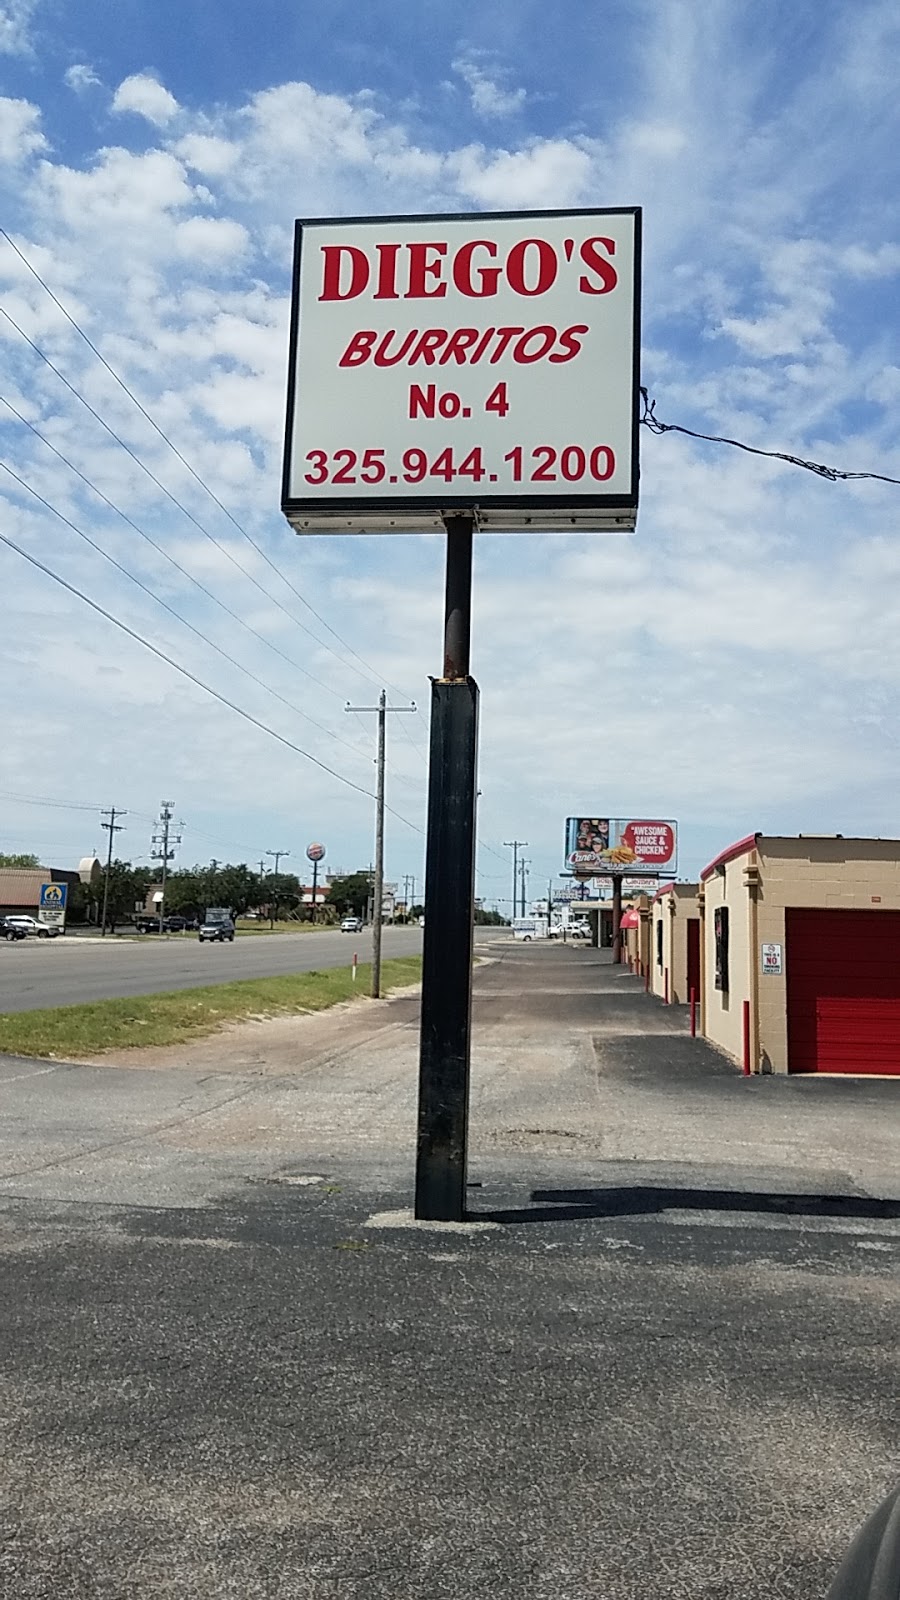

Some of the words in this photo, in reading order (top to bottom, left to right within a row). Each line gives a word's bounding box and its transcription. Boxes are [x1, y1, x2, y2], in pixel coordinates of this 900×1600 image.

[318, 237, 618, 302] DIEGO'S
[339, 324, 589, 367] BURRITOS
[409, 383, 471, 418] No.
[485, 382, 510, 417] 4
[304, 445, 616, 485] 325.944.1200
[635, 836, 657, 845] SAUCE
[658, 836, 665, 845] &
[766, 957, 777, 965] NO
